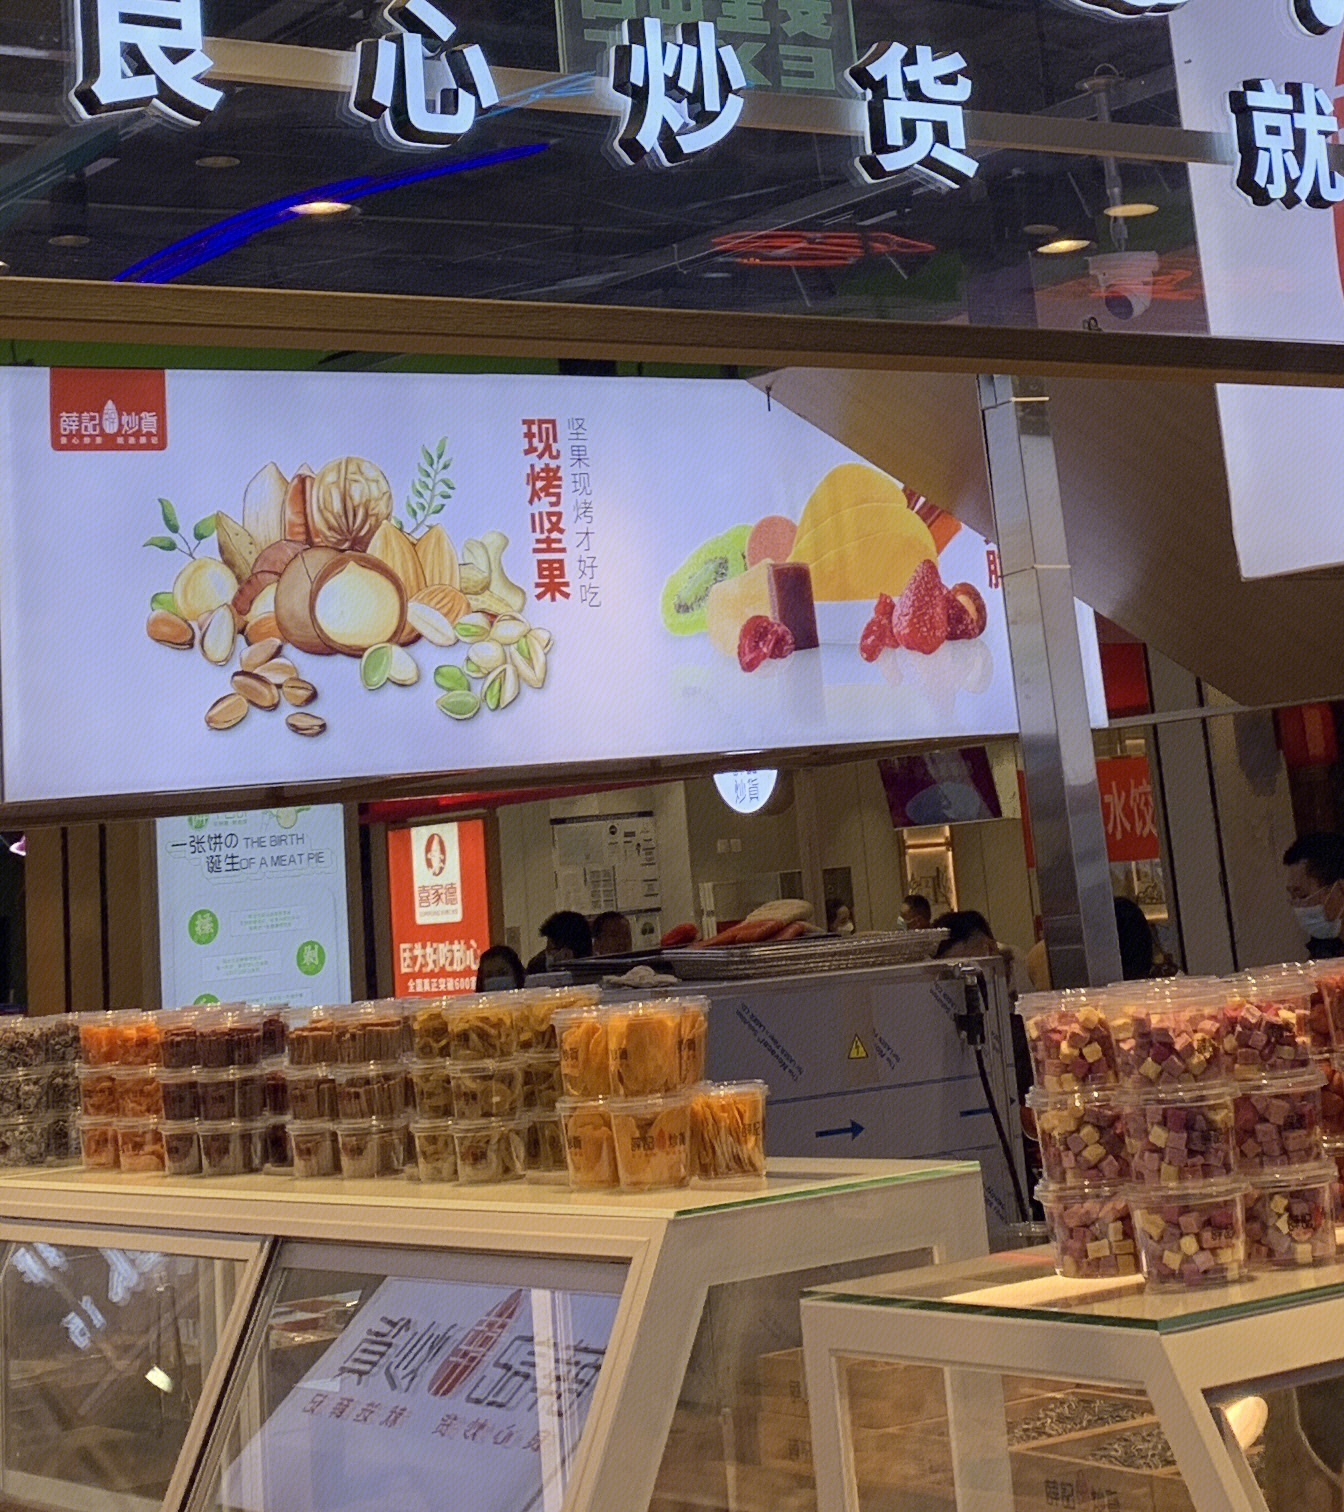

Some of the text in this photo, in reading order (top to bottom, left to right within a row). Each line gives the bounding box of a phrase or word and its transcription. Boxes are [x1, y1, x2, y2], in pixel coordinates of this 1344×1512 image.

[521, 418, 572, 603] 现烤坚果
[567, 417, 602, 608] 坚果现烤才好吃
[1104, 778, 1157, 840] 水饺
[171, 833, 305, 854] 一张饼の THE BIRTH
[239, 856, 256, 870] OF
[259, 855, 269, 867] A
[270, 853, 305, 867] MEAT
[307, 851, 325, 864] PIE
[417, 882, 458, 908] 喜家德
[399, 939, 481, 974] 因为好吃放心
